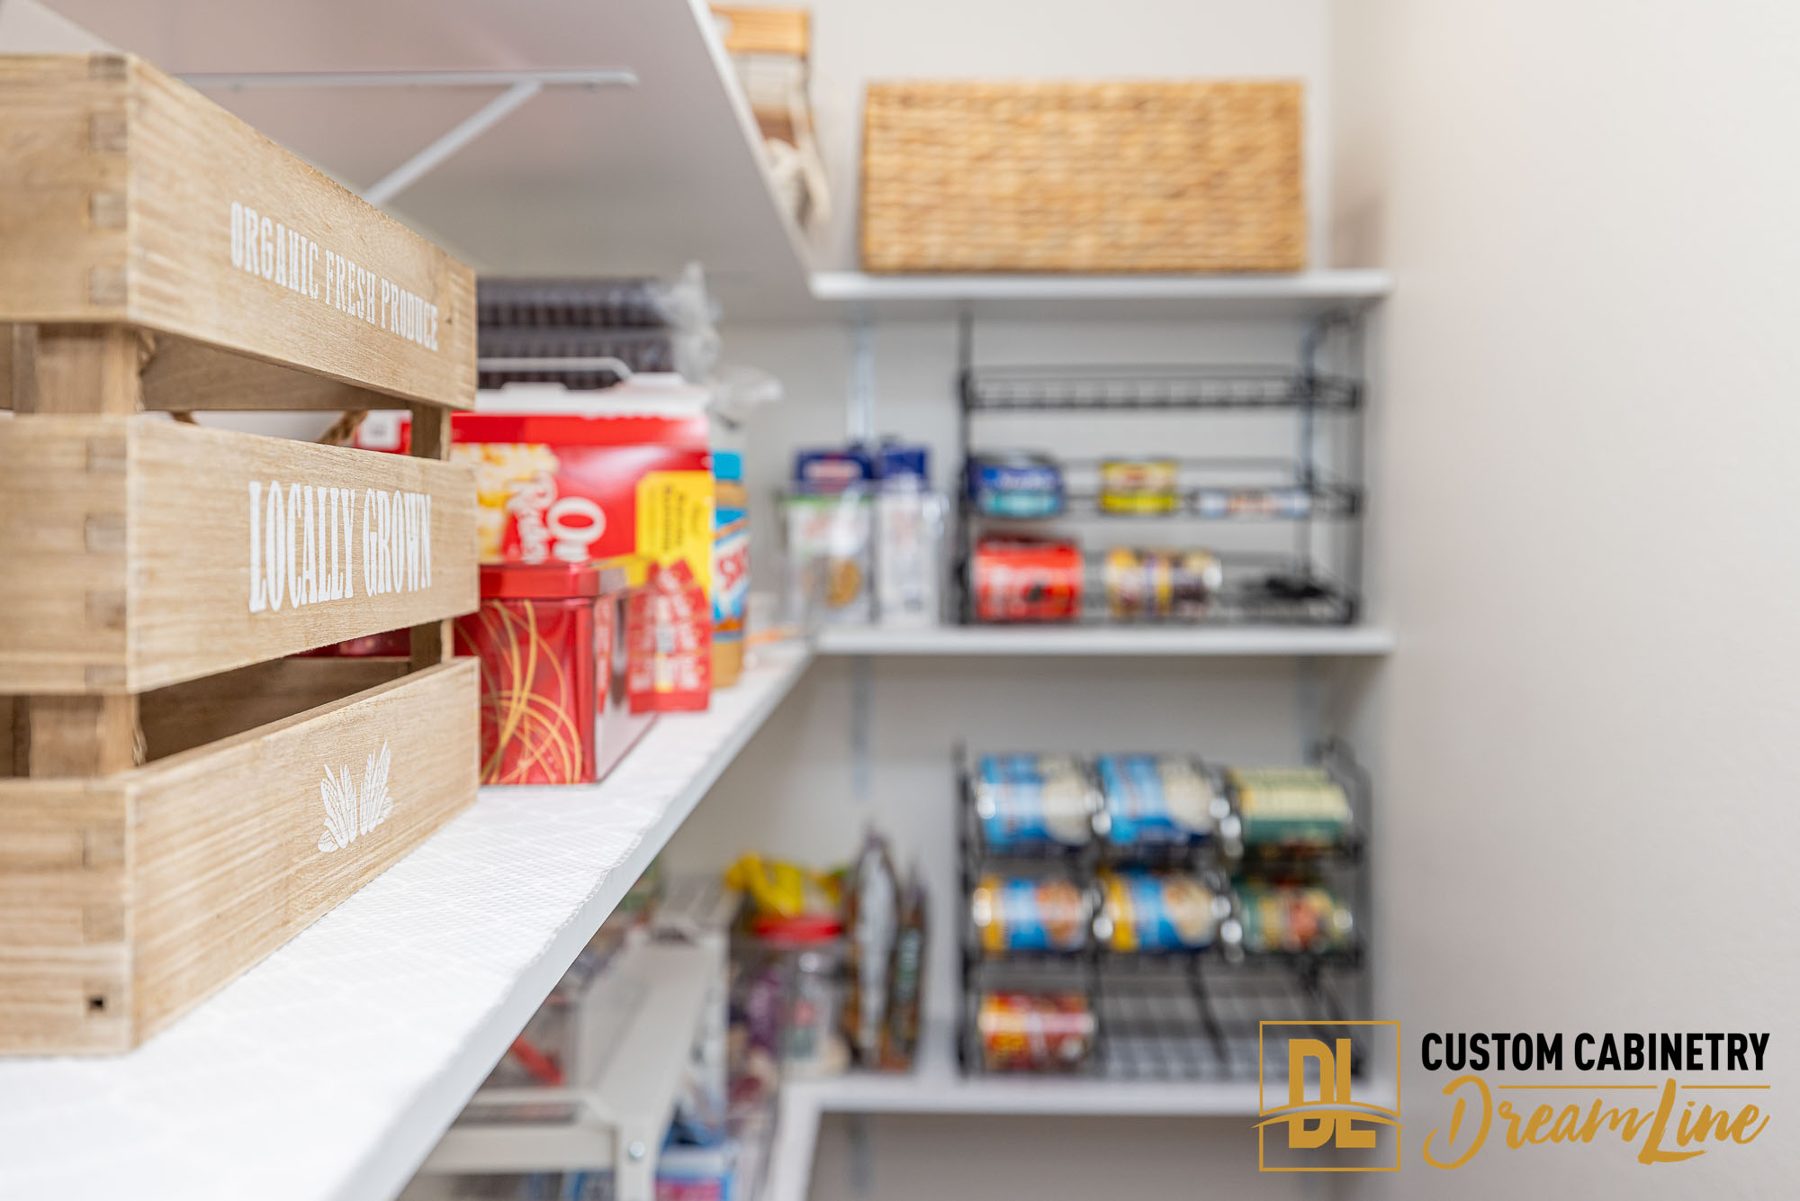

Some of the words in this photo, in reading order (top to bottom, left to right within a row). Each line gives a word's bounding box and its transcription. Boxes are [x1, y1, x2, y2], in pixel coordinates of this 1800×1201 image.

[230, 201, 319, 300] ORGANIC
[325, 249, 376, 325] FRESH
[381, 277, 438, 352] PRODUCE
[248, 480, 355, 613] LOCALLY
[362, 487, 432, 597] GROWN
